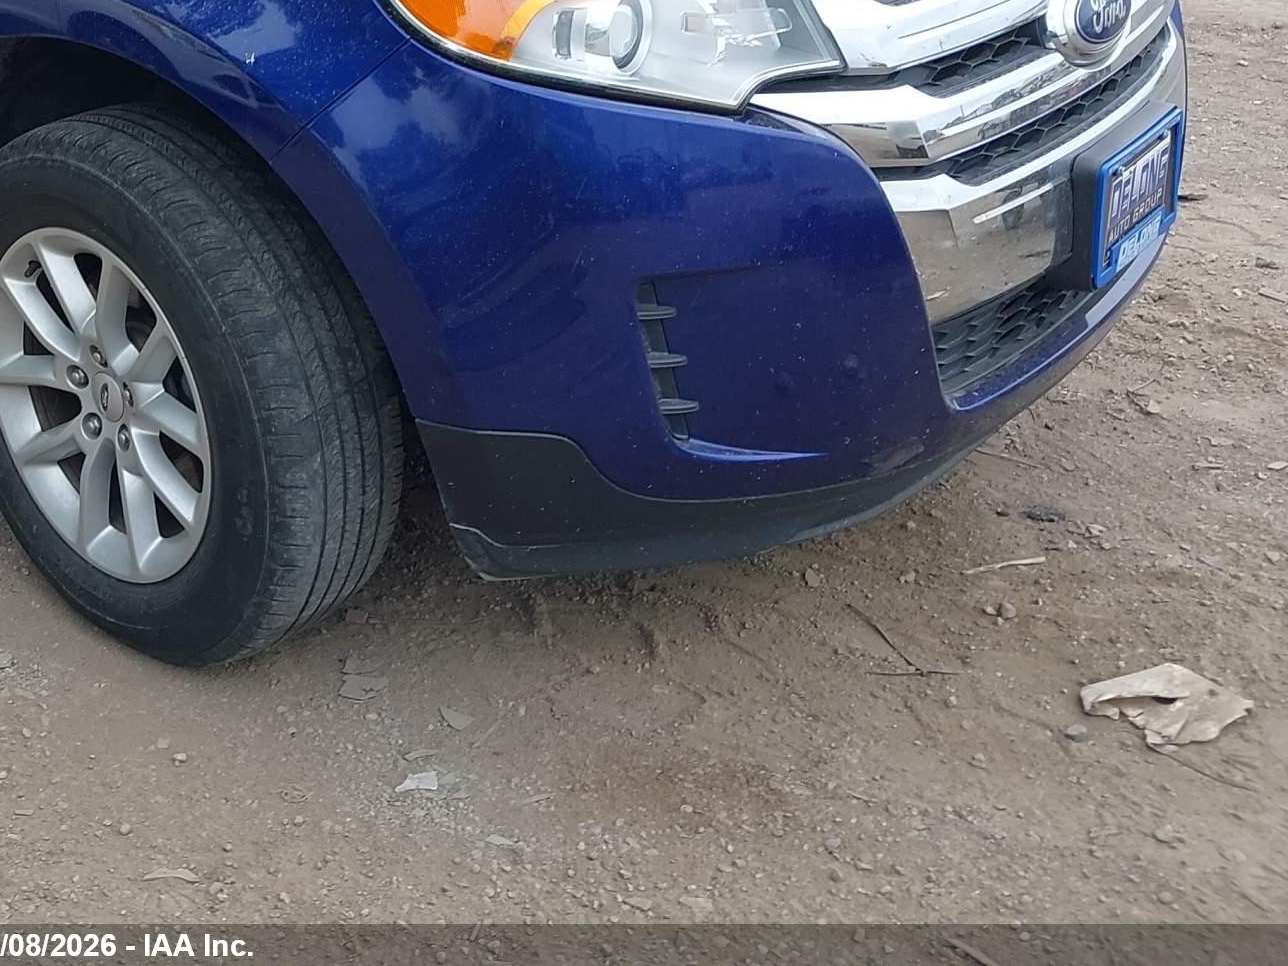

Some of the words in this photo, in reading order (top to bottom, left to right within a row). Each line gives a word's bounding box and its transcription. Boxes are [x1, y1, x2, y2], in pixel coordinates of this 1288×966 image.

[1111, 146, 1170, 219] DELONG
[1108, 215, 1130, 244] AUTO
[1132, 188, 1163, 223] GROUP
